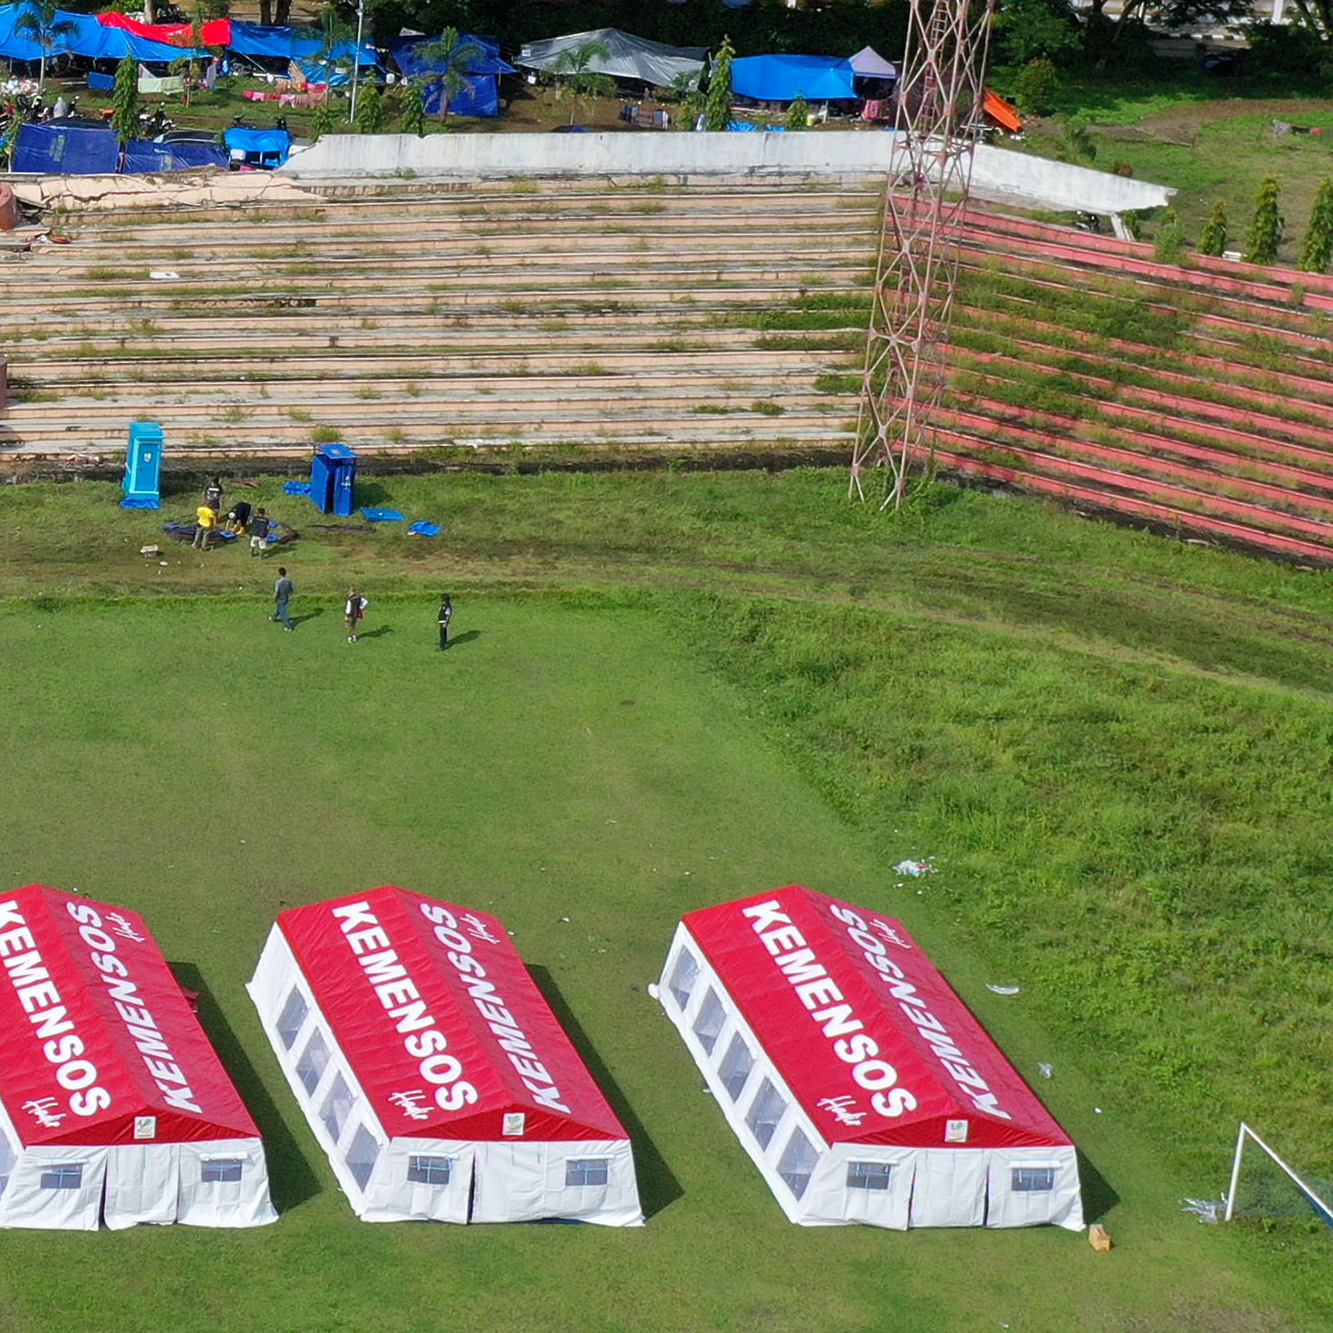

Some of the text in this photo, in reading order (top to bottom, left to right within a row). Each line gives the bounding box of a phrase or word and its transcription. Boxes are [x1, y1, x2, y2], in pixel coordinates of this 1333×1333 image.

[66, 901, 203, 1114] KEMENSOS
[332, 900, 479, 1111] KEMENSOS
[420, 903, 572, 1114] KEMENSOS
[742, 900, 918, 1118] KEMENSOS
[829, 904, 1012, 1120] KEMENSOS
